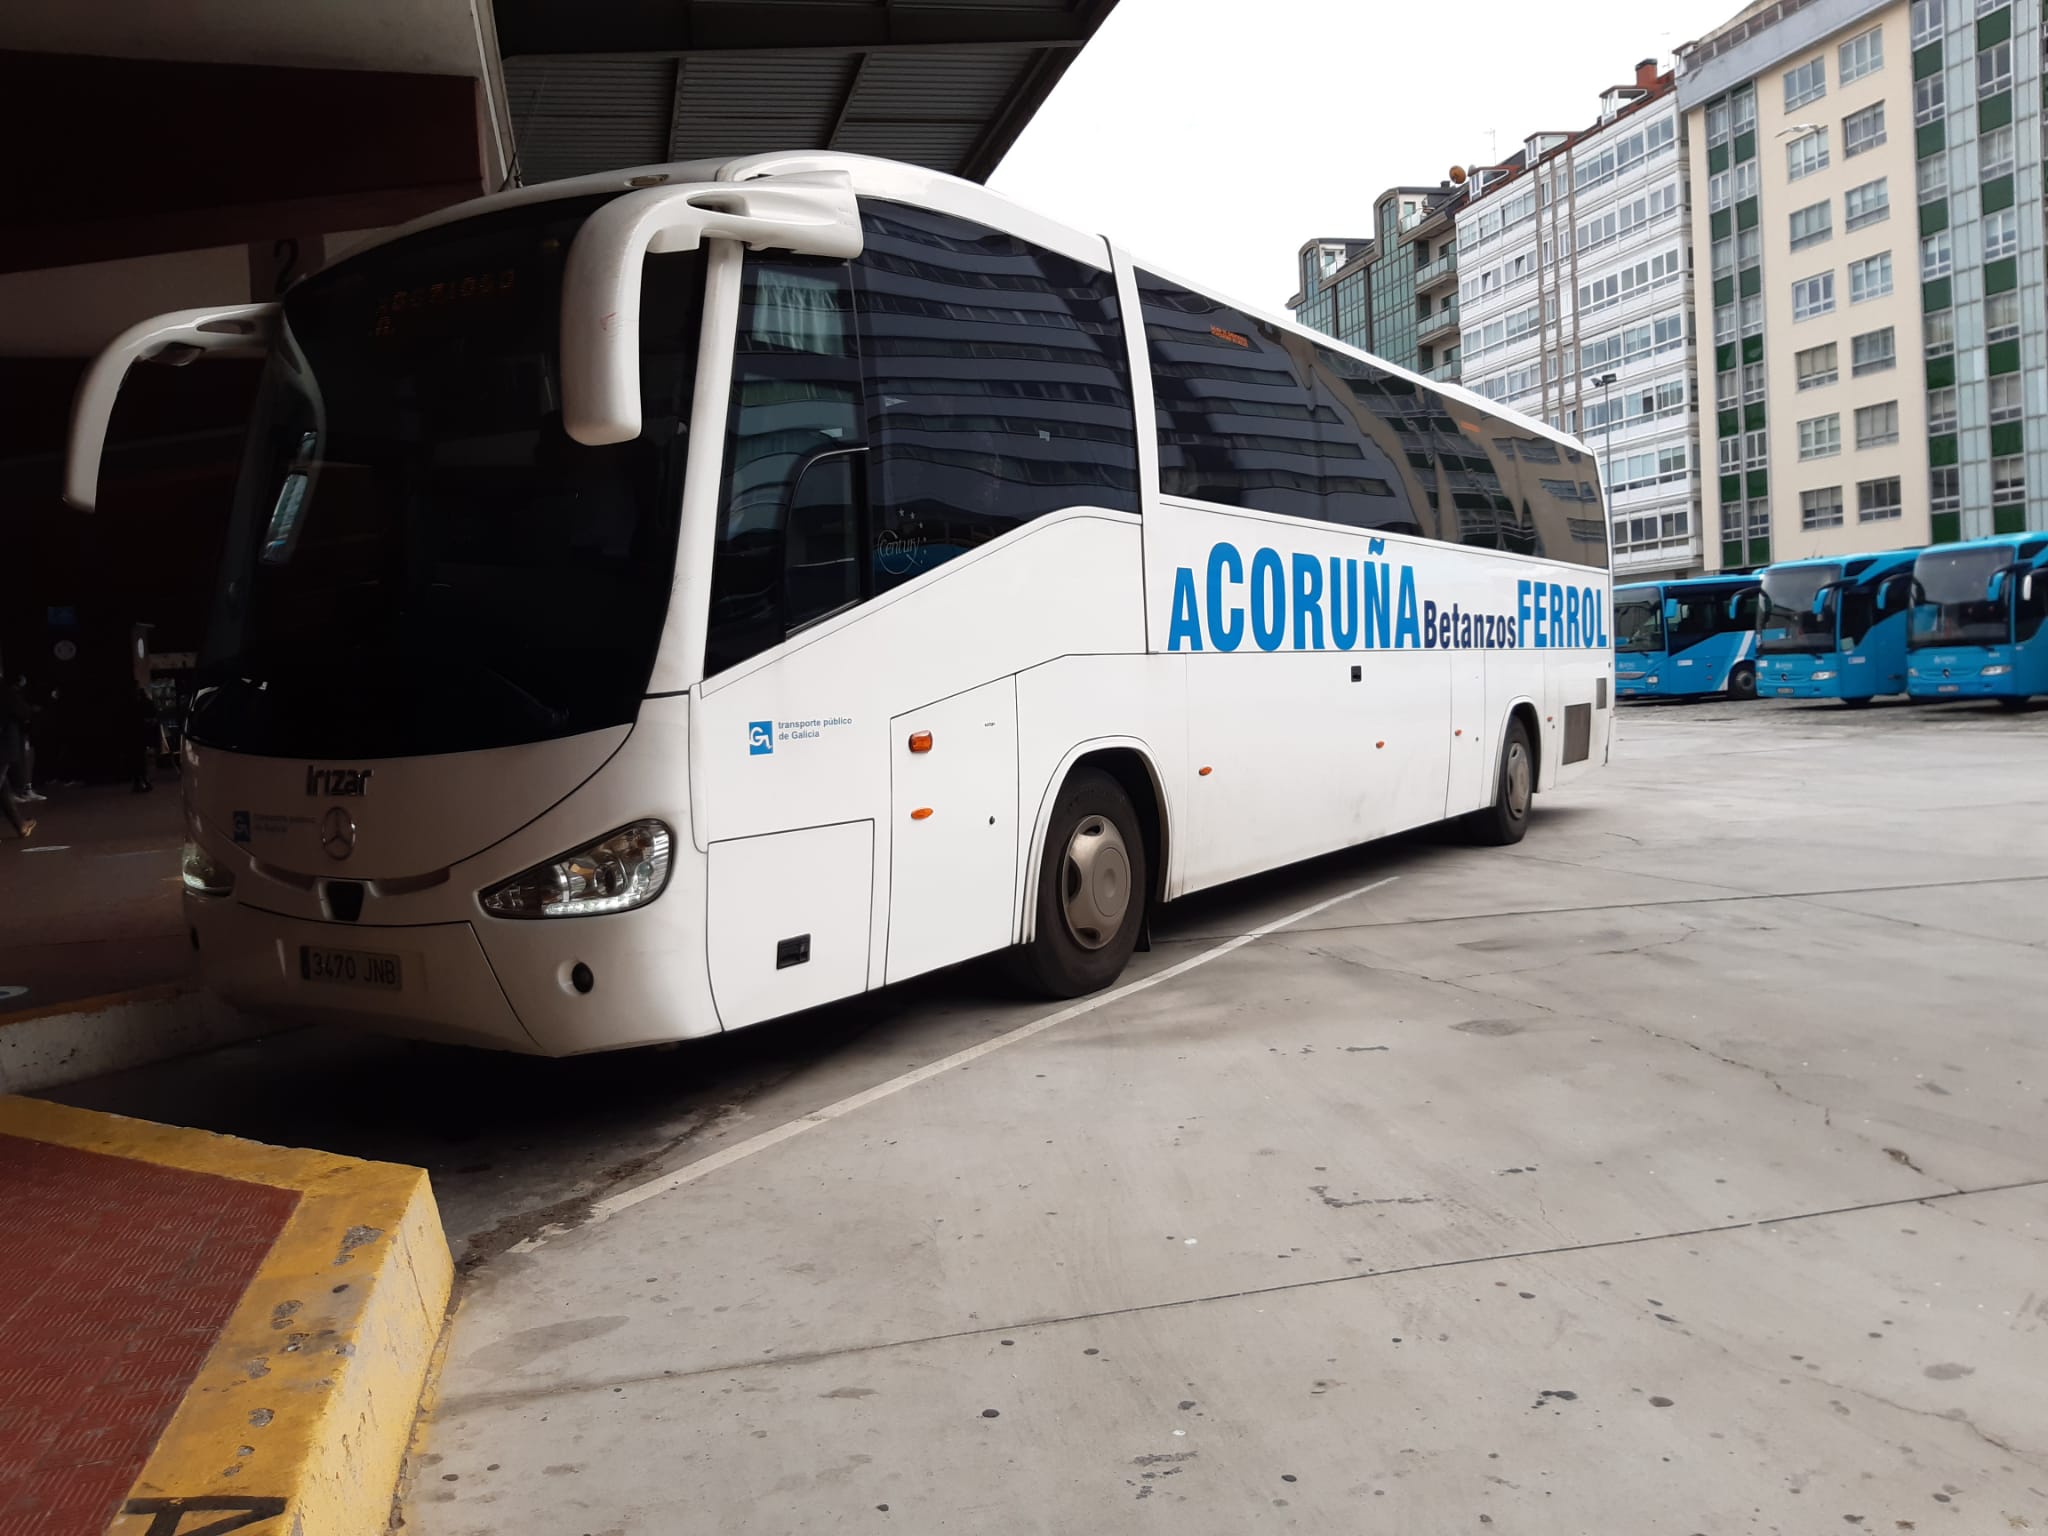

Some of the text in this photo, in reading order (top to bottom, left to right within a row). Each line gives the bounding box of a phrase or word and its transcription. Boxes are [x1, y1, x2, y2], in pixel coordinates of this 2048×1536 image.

[1424, 600, 1516, 649] Betanzos
[1517, 579, 1607, 649] FERROL
[778, 717, 853, 729] transporte público
[778, 730, 820, 740] de Galicia
[312, 952, 396, 985] 3470 JNB
